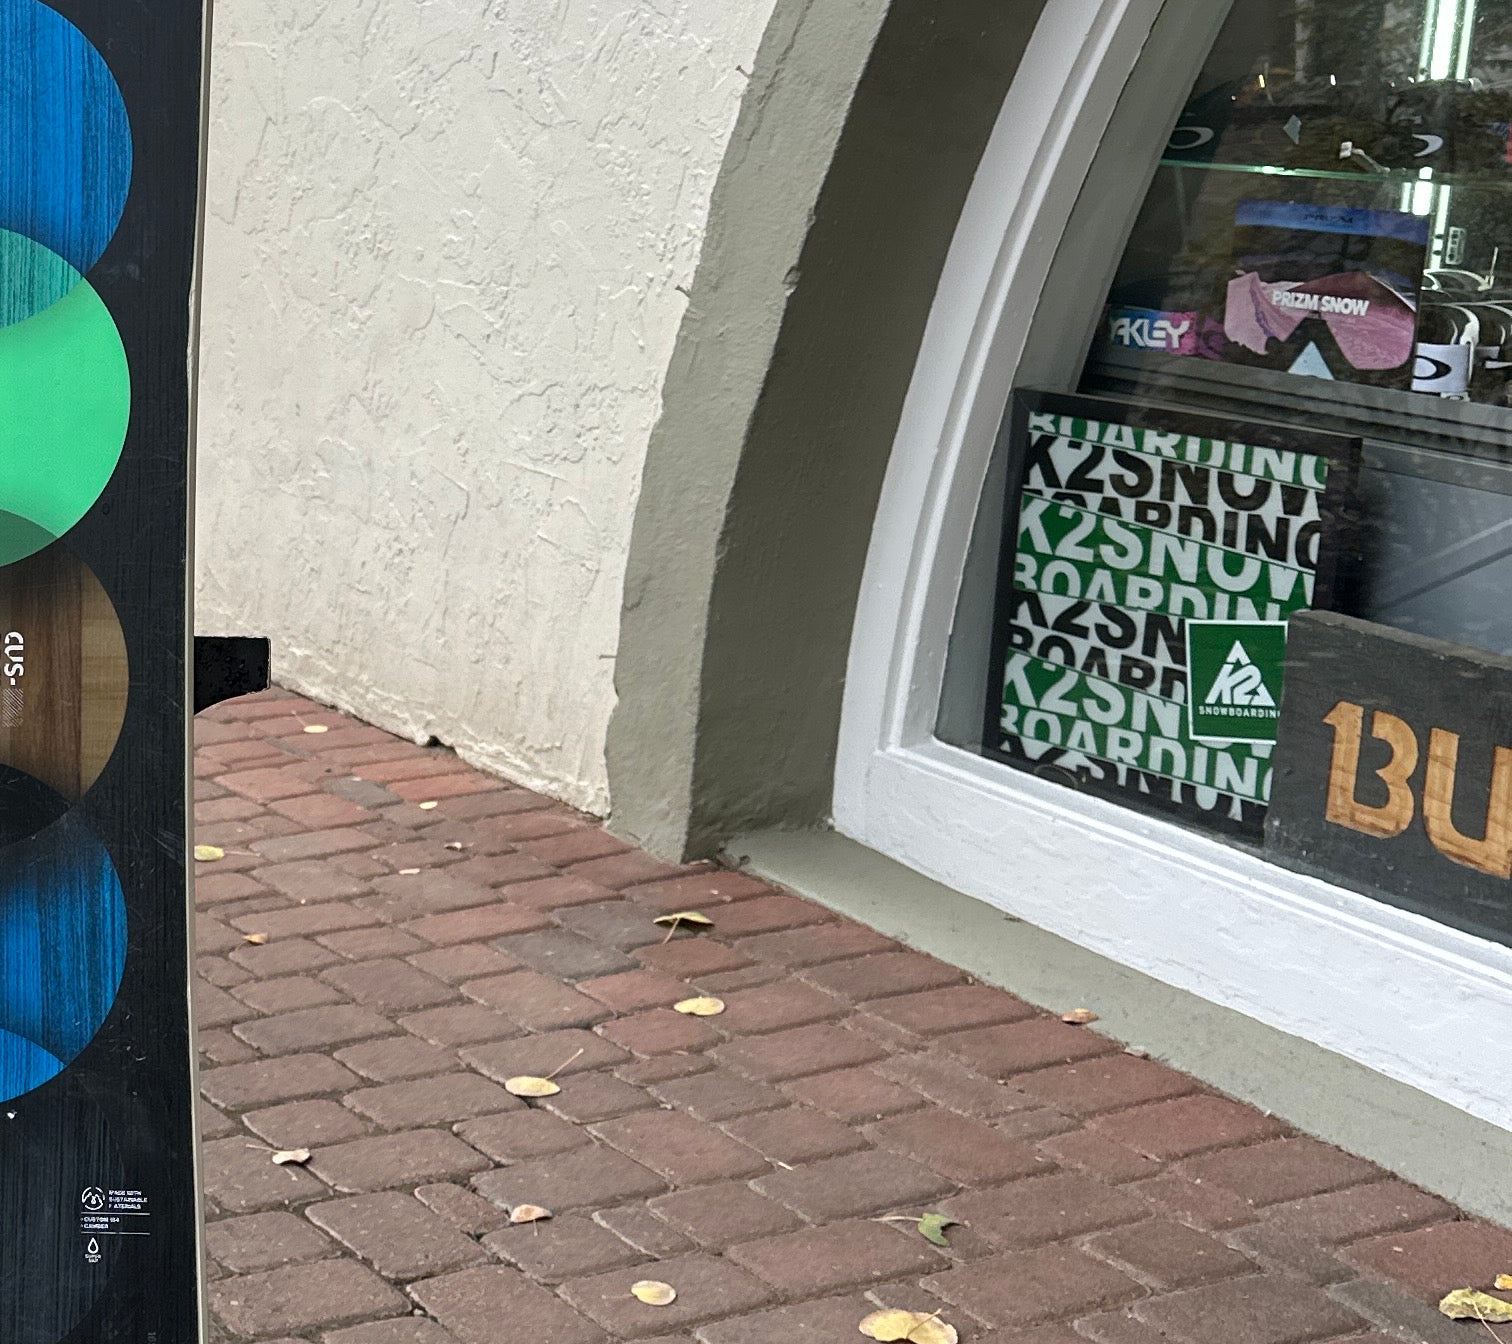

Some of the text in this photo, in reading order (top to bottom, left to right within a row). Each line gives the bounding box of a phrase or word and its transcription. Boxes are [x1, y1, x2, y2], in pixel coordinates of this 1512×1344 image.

[1110, 317, 1190, 348] AKLEY
[1271, 290, 1369, 316] PRIZM SNOW
[1013, 552, 1282, 621] BOARDIN
[1009, 592, 1187, 666] K2SN
[1002, 651, 1181, 739] K2SN
[1006, 625, 1187, 705] BOARD
[1205, 663, 1276, 707] K2
[1199, 705, 1281, 719] SNOWBOARDIN
[1000, 703, 1272, 802] BOARDIN
